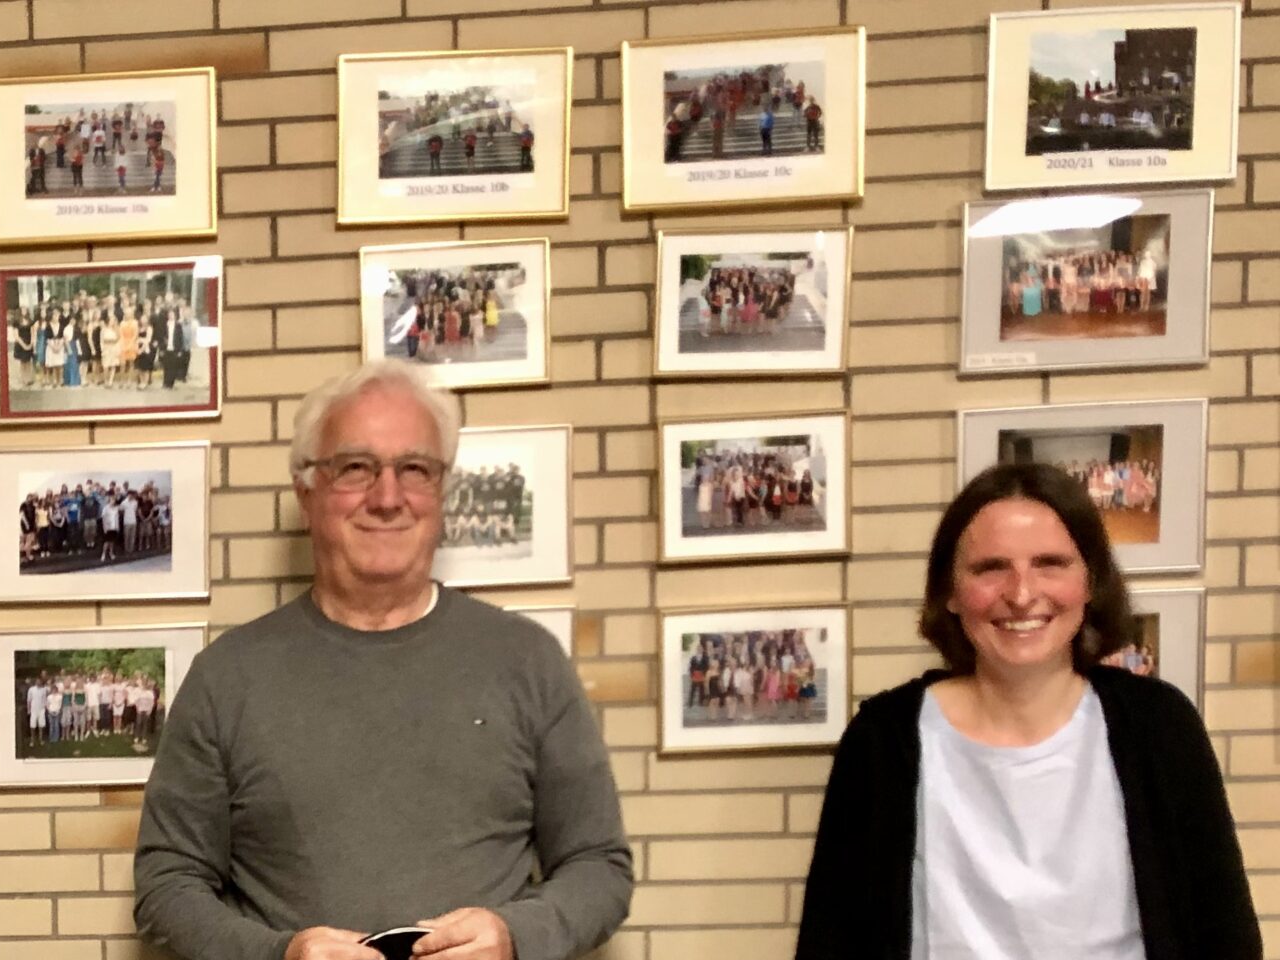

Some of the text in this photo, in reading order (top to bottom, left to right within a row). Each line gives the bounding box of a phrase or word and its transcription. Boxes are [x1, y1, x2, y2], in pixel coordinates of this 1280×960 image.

[1046, 155, 1167, 169] 2020/21 Klasse 10a
[734, 168, 769, 179] Klasse
[775, 166, 792, 177] 10c
[407, 181, 510, 196] 2019/20 Klasse 10b
[56, 203, 95, 216] 2019/20
[97, 203, 128, 214] Klasse
